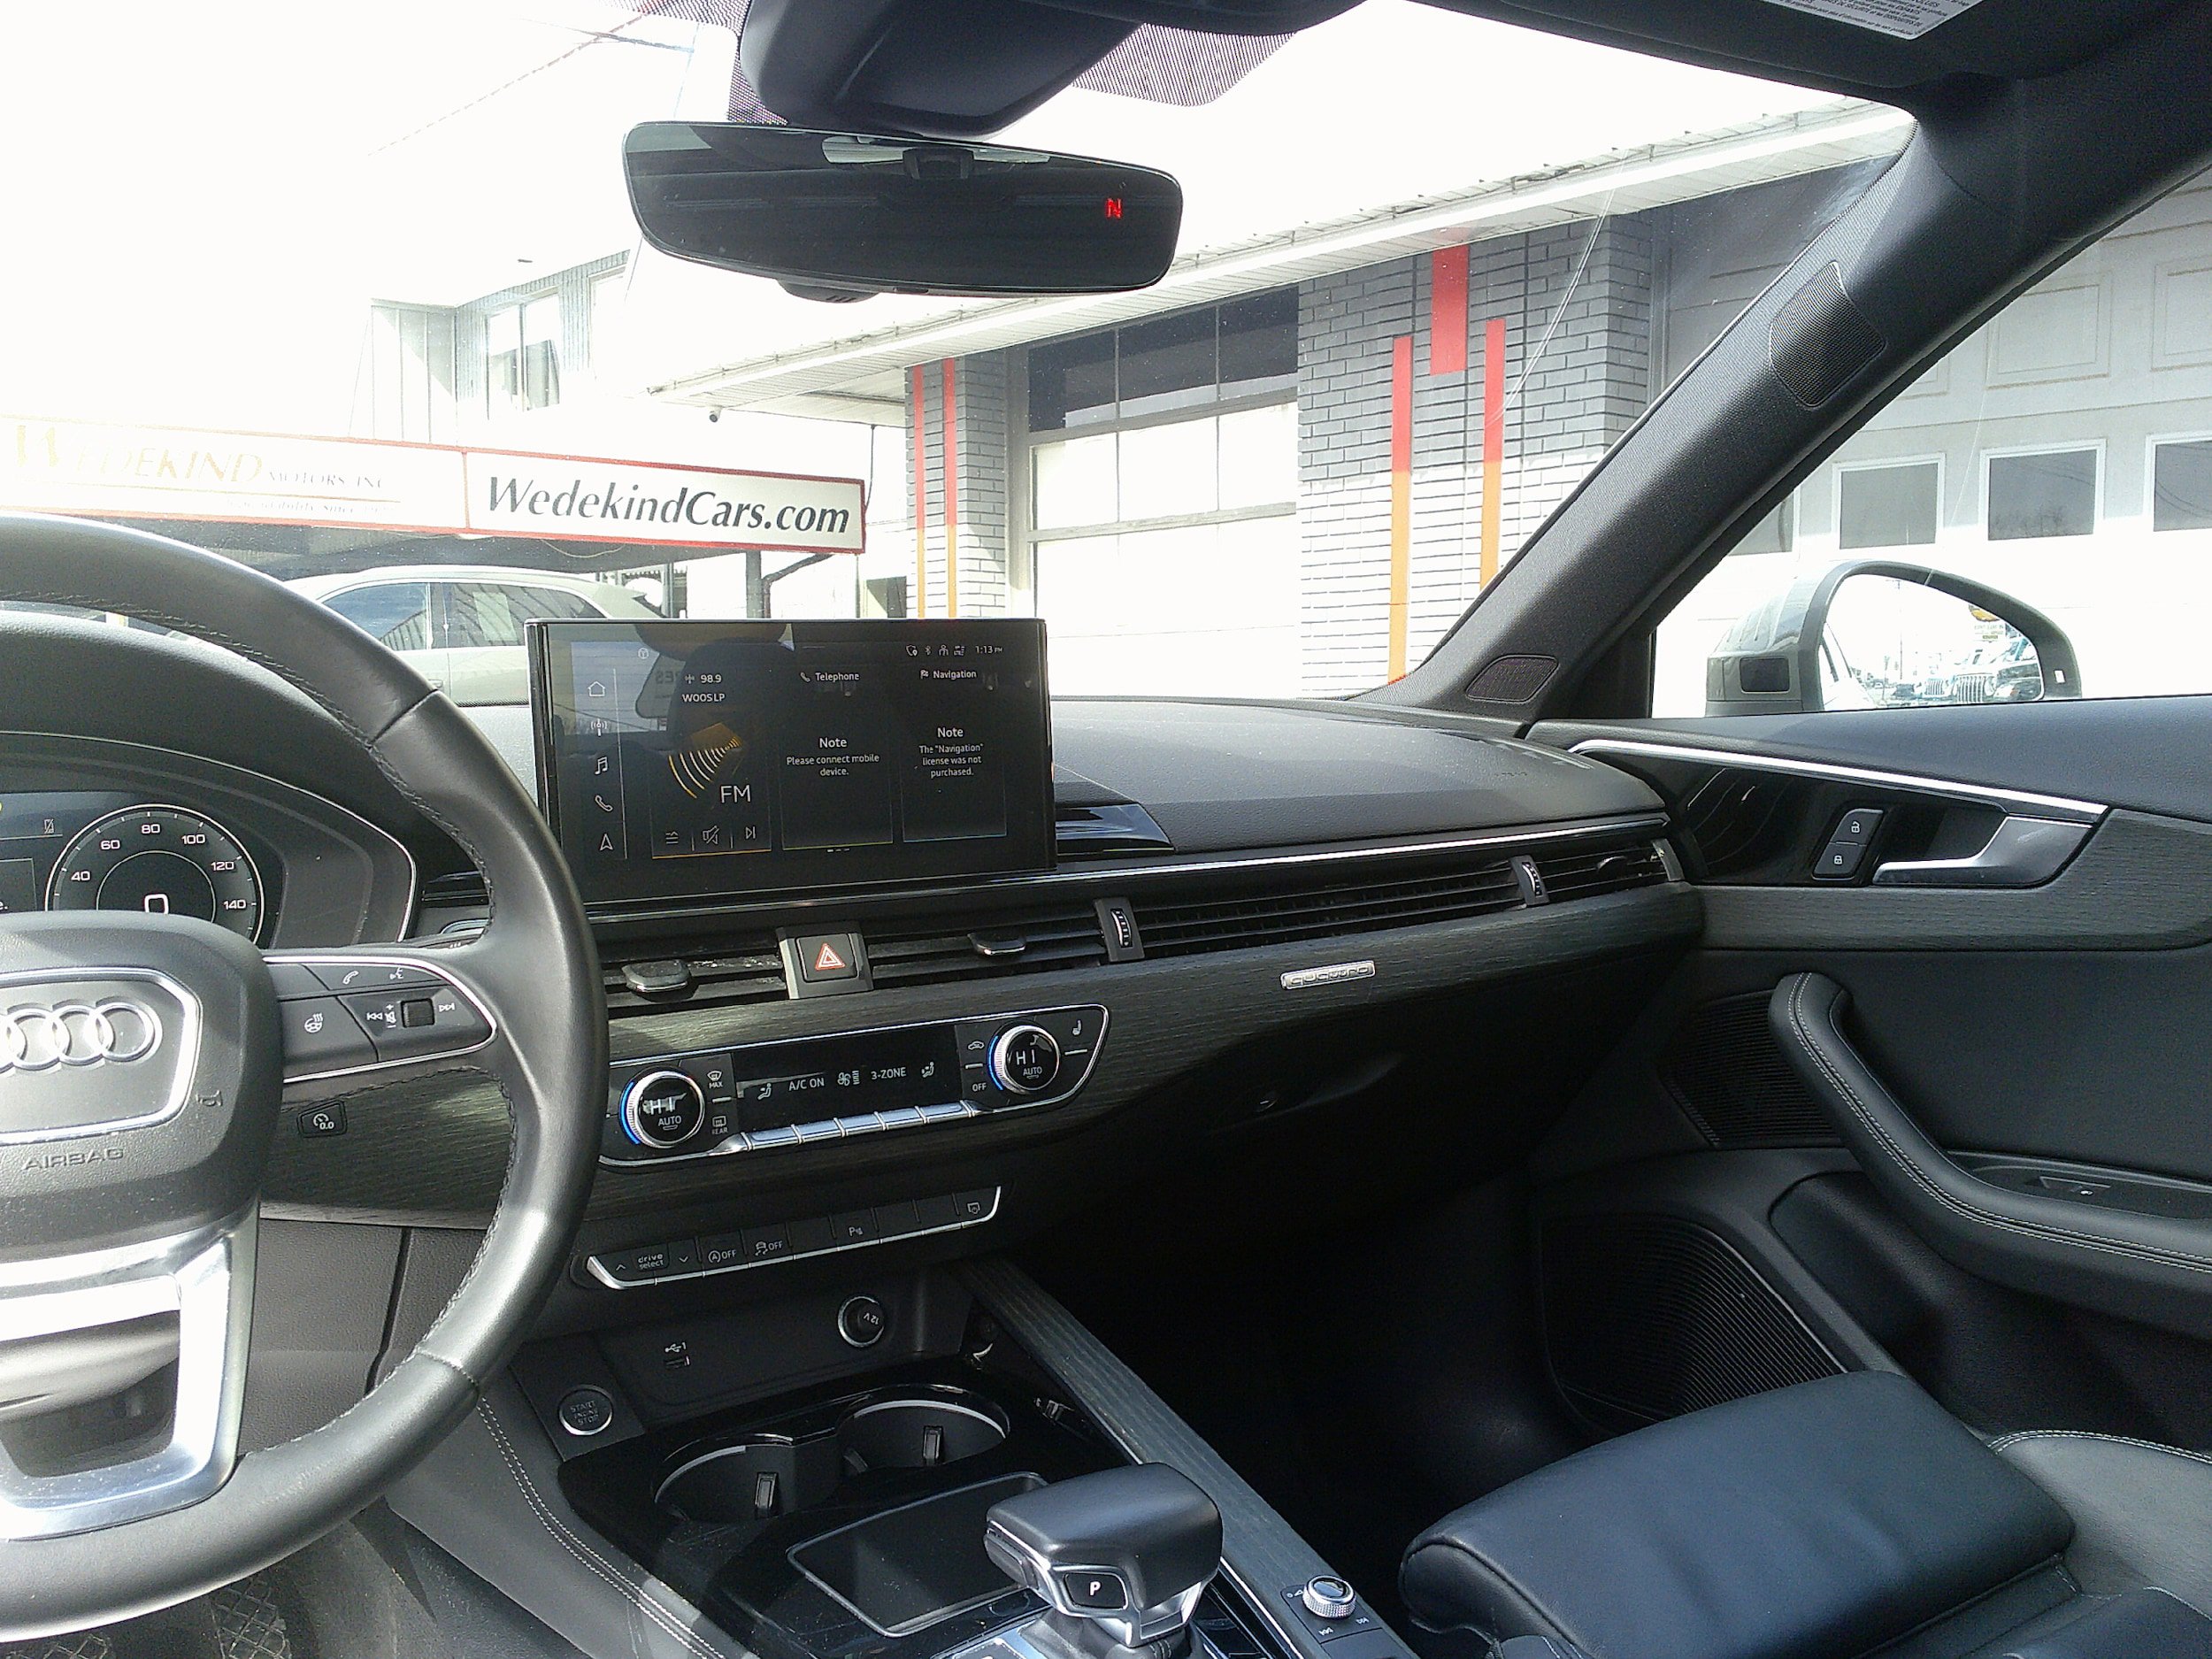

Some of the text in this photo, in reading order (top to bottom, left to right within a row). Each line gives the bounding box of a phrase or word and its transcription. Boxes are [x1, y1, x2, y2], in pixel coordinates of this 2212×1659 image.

[1106, 198, 1121, 219] N
[489, 477, 849, 534] WedekindCars.com
[975, 645, 993, 654] 1:13
[700, 673, 722, 683] 98.9
[815, 672, 860, 683] Telephone
[933, 670, 977, 680] Navigation
[937, 726, 964, 738] Note
[819, 737, 848, 749] Note
[918, 743, 984, 755] The "Navigation"
[786, 754, 880, 766] Please connect mobile
[922, 757, 949, 766] license
[968, 755, 982, 764] not
[819, 767, 849, 777] device.
[930, 767, 974, 780] purchased.
[720, 785, 752, 803] FM
[141, 824, 161, 834] 80
[100, 840, 120, 850] 60
[181, 833, 205, 845] 100
[211, 860, 235, 872] 120
[71, 871, 91, 881] 40
[224, 899, 247, 910] 140
[871, 1066, 907, 1080] 3-ZONE
[1023, 1066, 1043, 1077] AUTO
[709, 1080, 724, 1089] MAX
[788, 1077, 825, 1092] A/C ON
[972, 1082, 987, 1092] OFF
[319, 1121, 334, 1130] 0.0
[658, 1115, 682, 1127] AUTO
[712, 1126, 728, 1135] REAR
[23, 1148, 125, 1171] AIRBAG
[768, 1240, 784, 1252] OFF
[637, 1253, 664, 1264] drive
[721, 1248, 737, 1260] OFF
[638, 1259, 664, 1271] select
[1089, 1581, 1102, 1596] P
